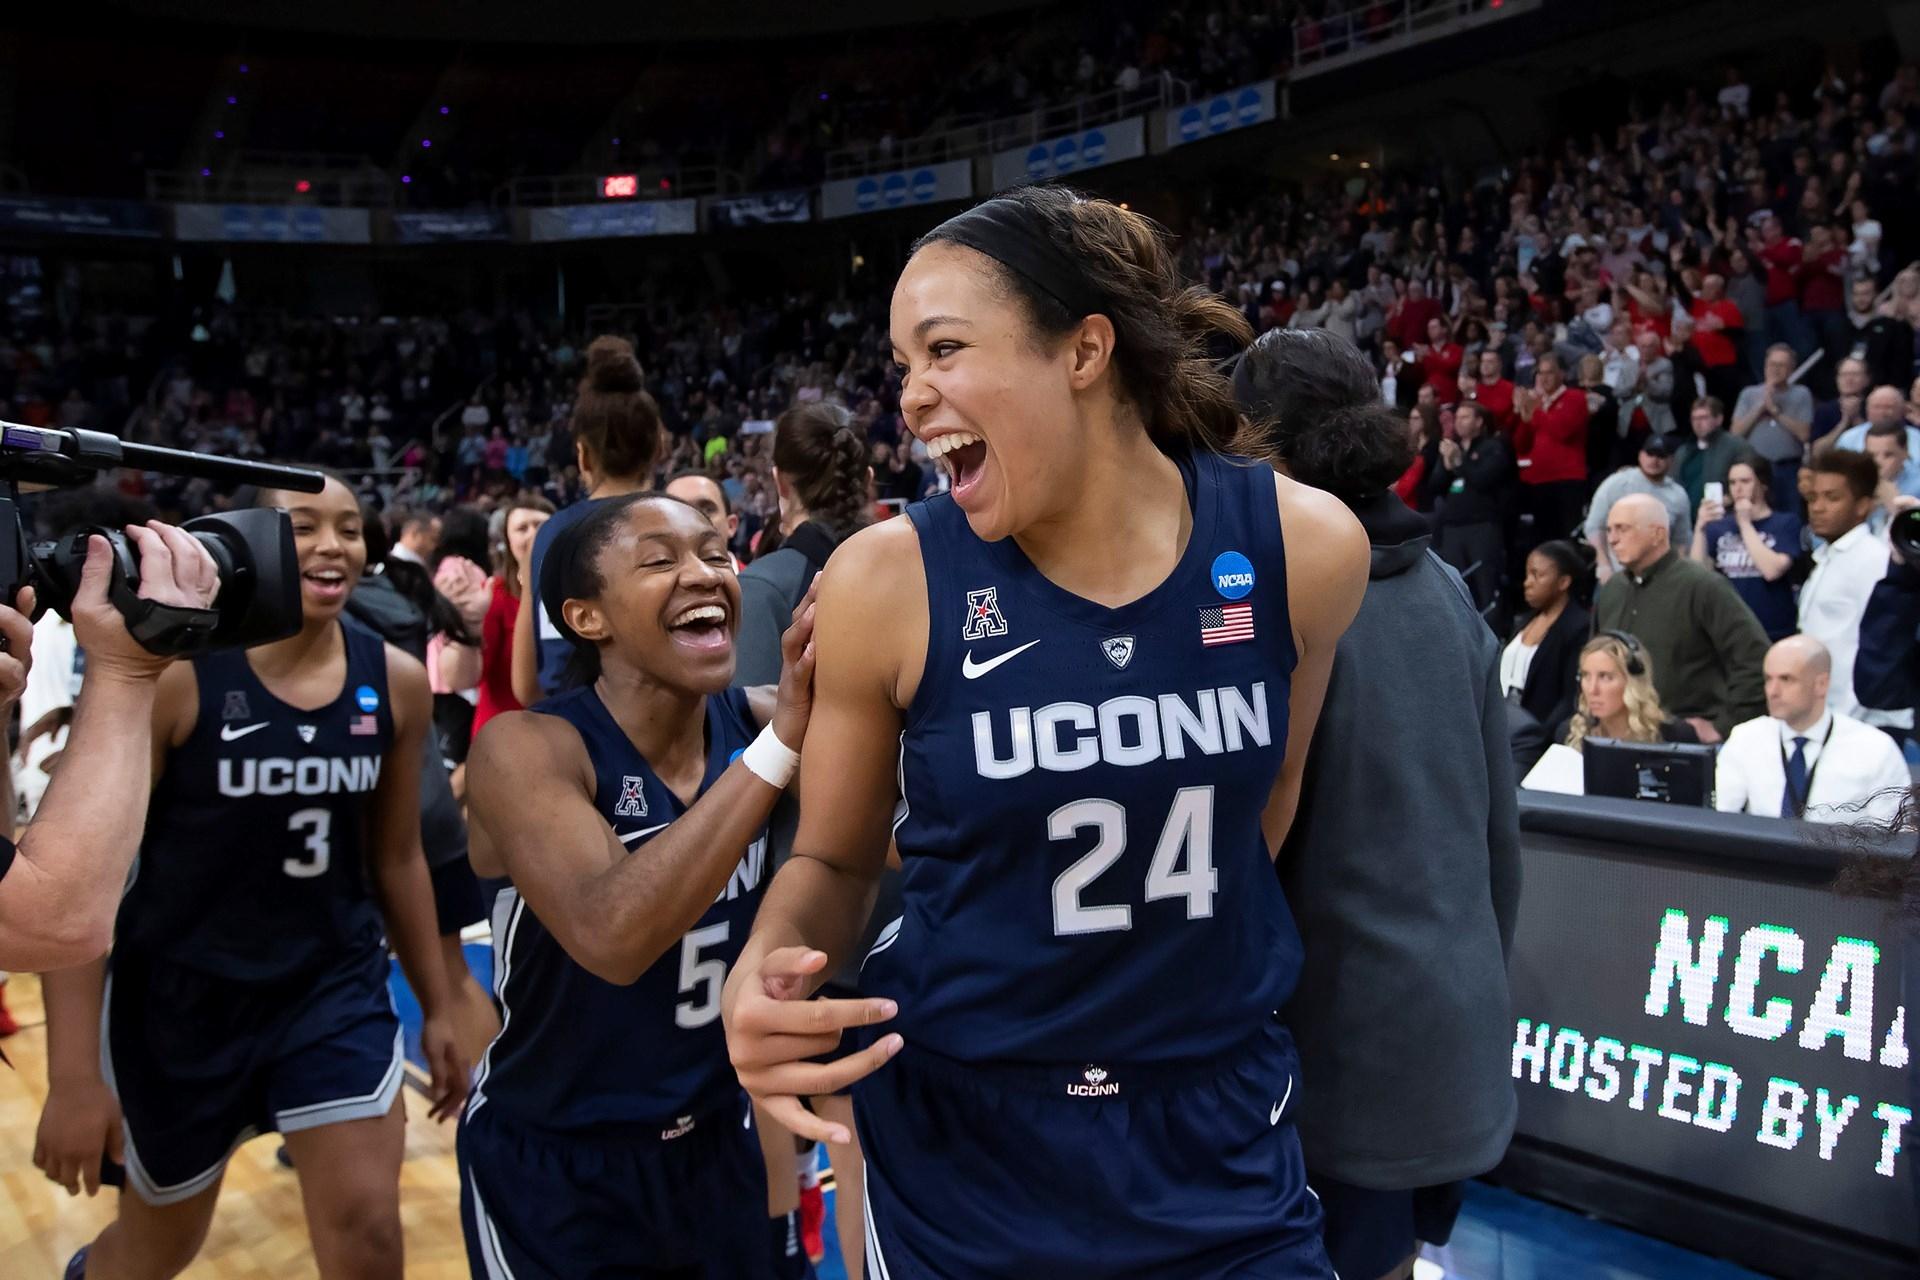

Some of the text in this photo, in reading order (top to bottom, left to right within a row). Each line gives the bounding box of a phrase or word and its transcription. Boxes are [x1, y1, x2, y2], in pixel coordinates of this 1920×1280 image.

[1218, 573, 1253, 588] NCAA
[972, 682, 1271, 779] UCONN
[218, 754, 382, 797] UCONN
[283, 807, 331, 878] 3
[1047, 785, 1218, 936] 24
[675, 920, 730, 1029] 5
[1067, 1082, 1119, 1096] UCONN
[1511, 1018, 1742, 1132] HOSTED
[1756, 1076, 1860, 1160] BY
